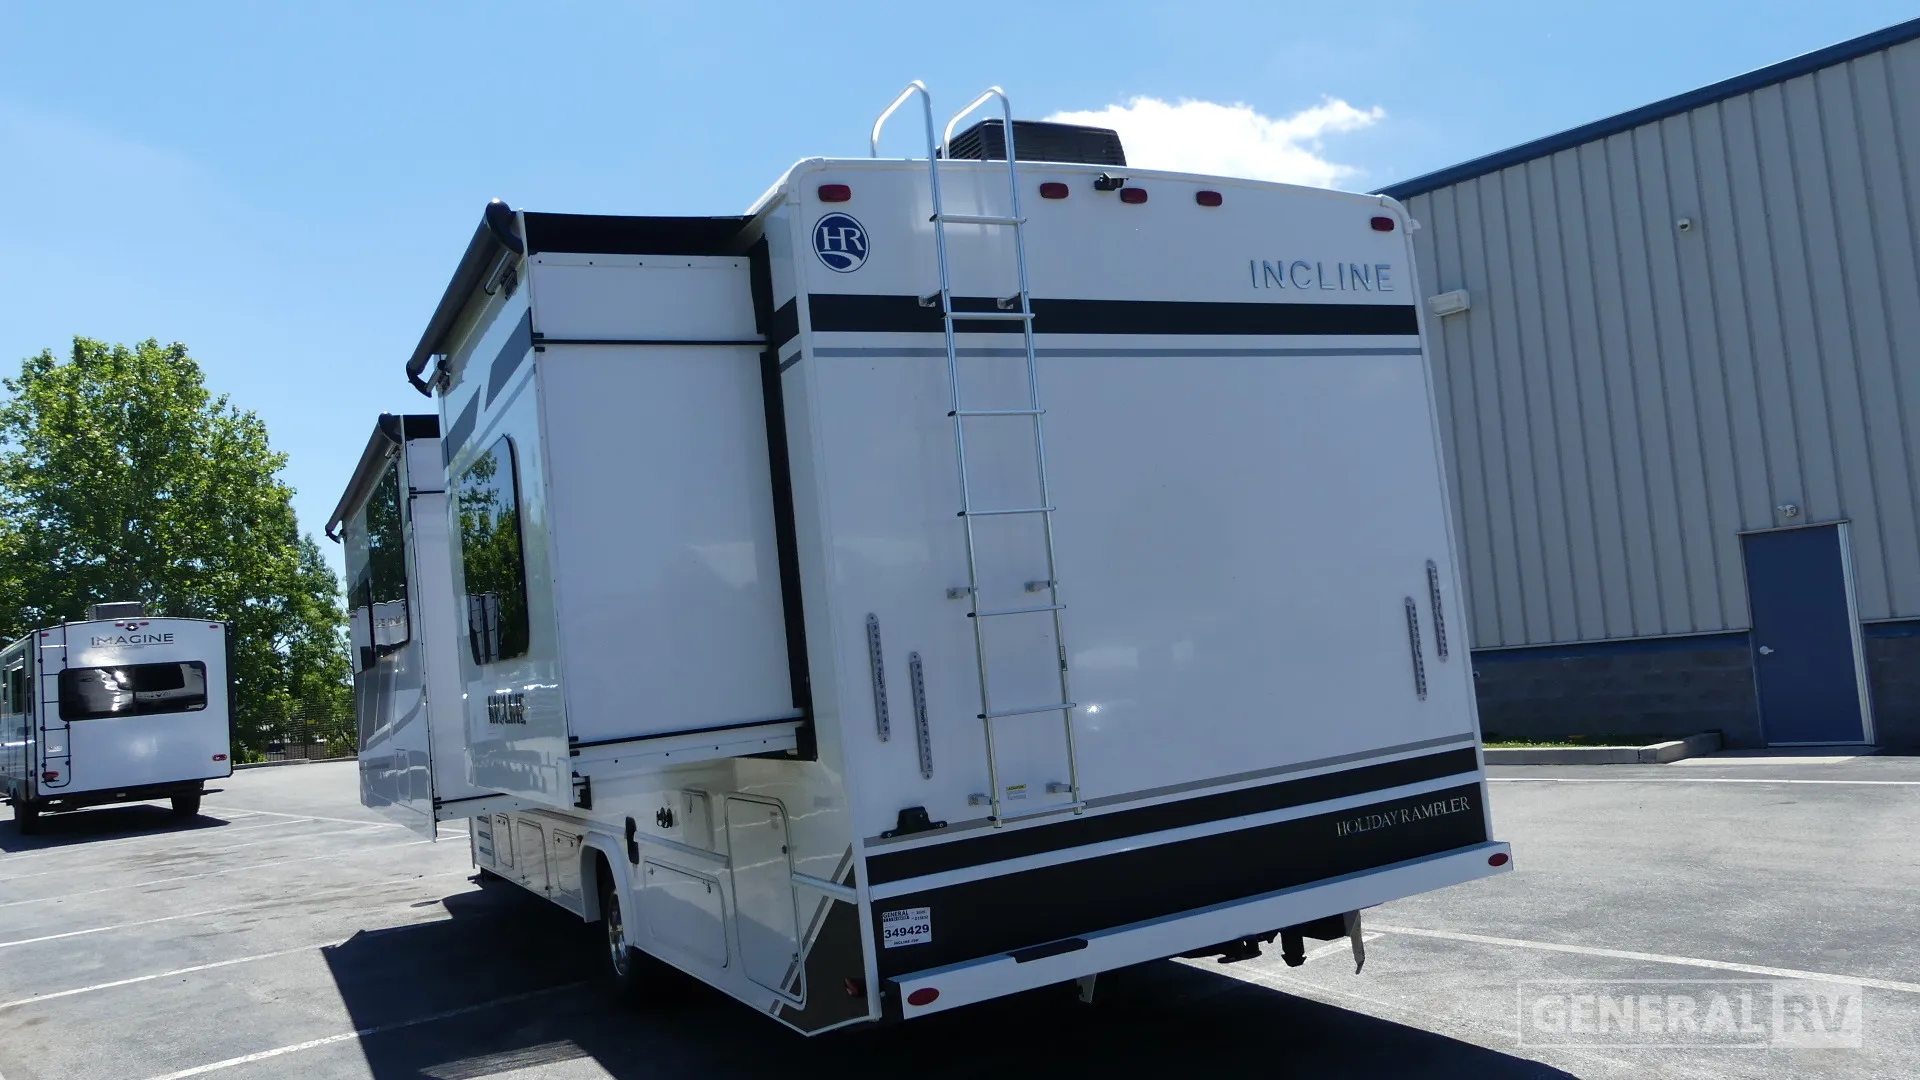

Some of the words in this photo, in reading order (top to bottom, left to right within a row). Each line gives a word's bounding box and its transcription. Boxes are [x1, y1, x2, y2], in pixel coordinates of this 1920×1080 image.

[821, 226, 865, 251] HR
[1249, 259, 1394, 292] INCLINE
[91, 633, 174, 646] IMAGINE
[1335, 810, 1399, 837] HOLIDAY
[1400, 796, 1471, 824] RAMBLER
[882, 910, 909, 919] GENERAL
[884, 924, 930, 939] 349429
